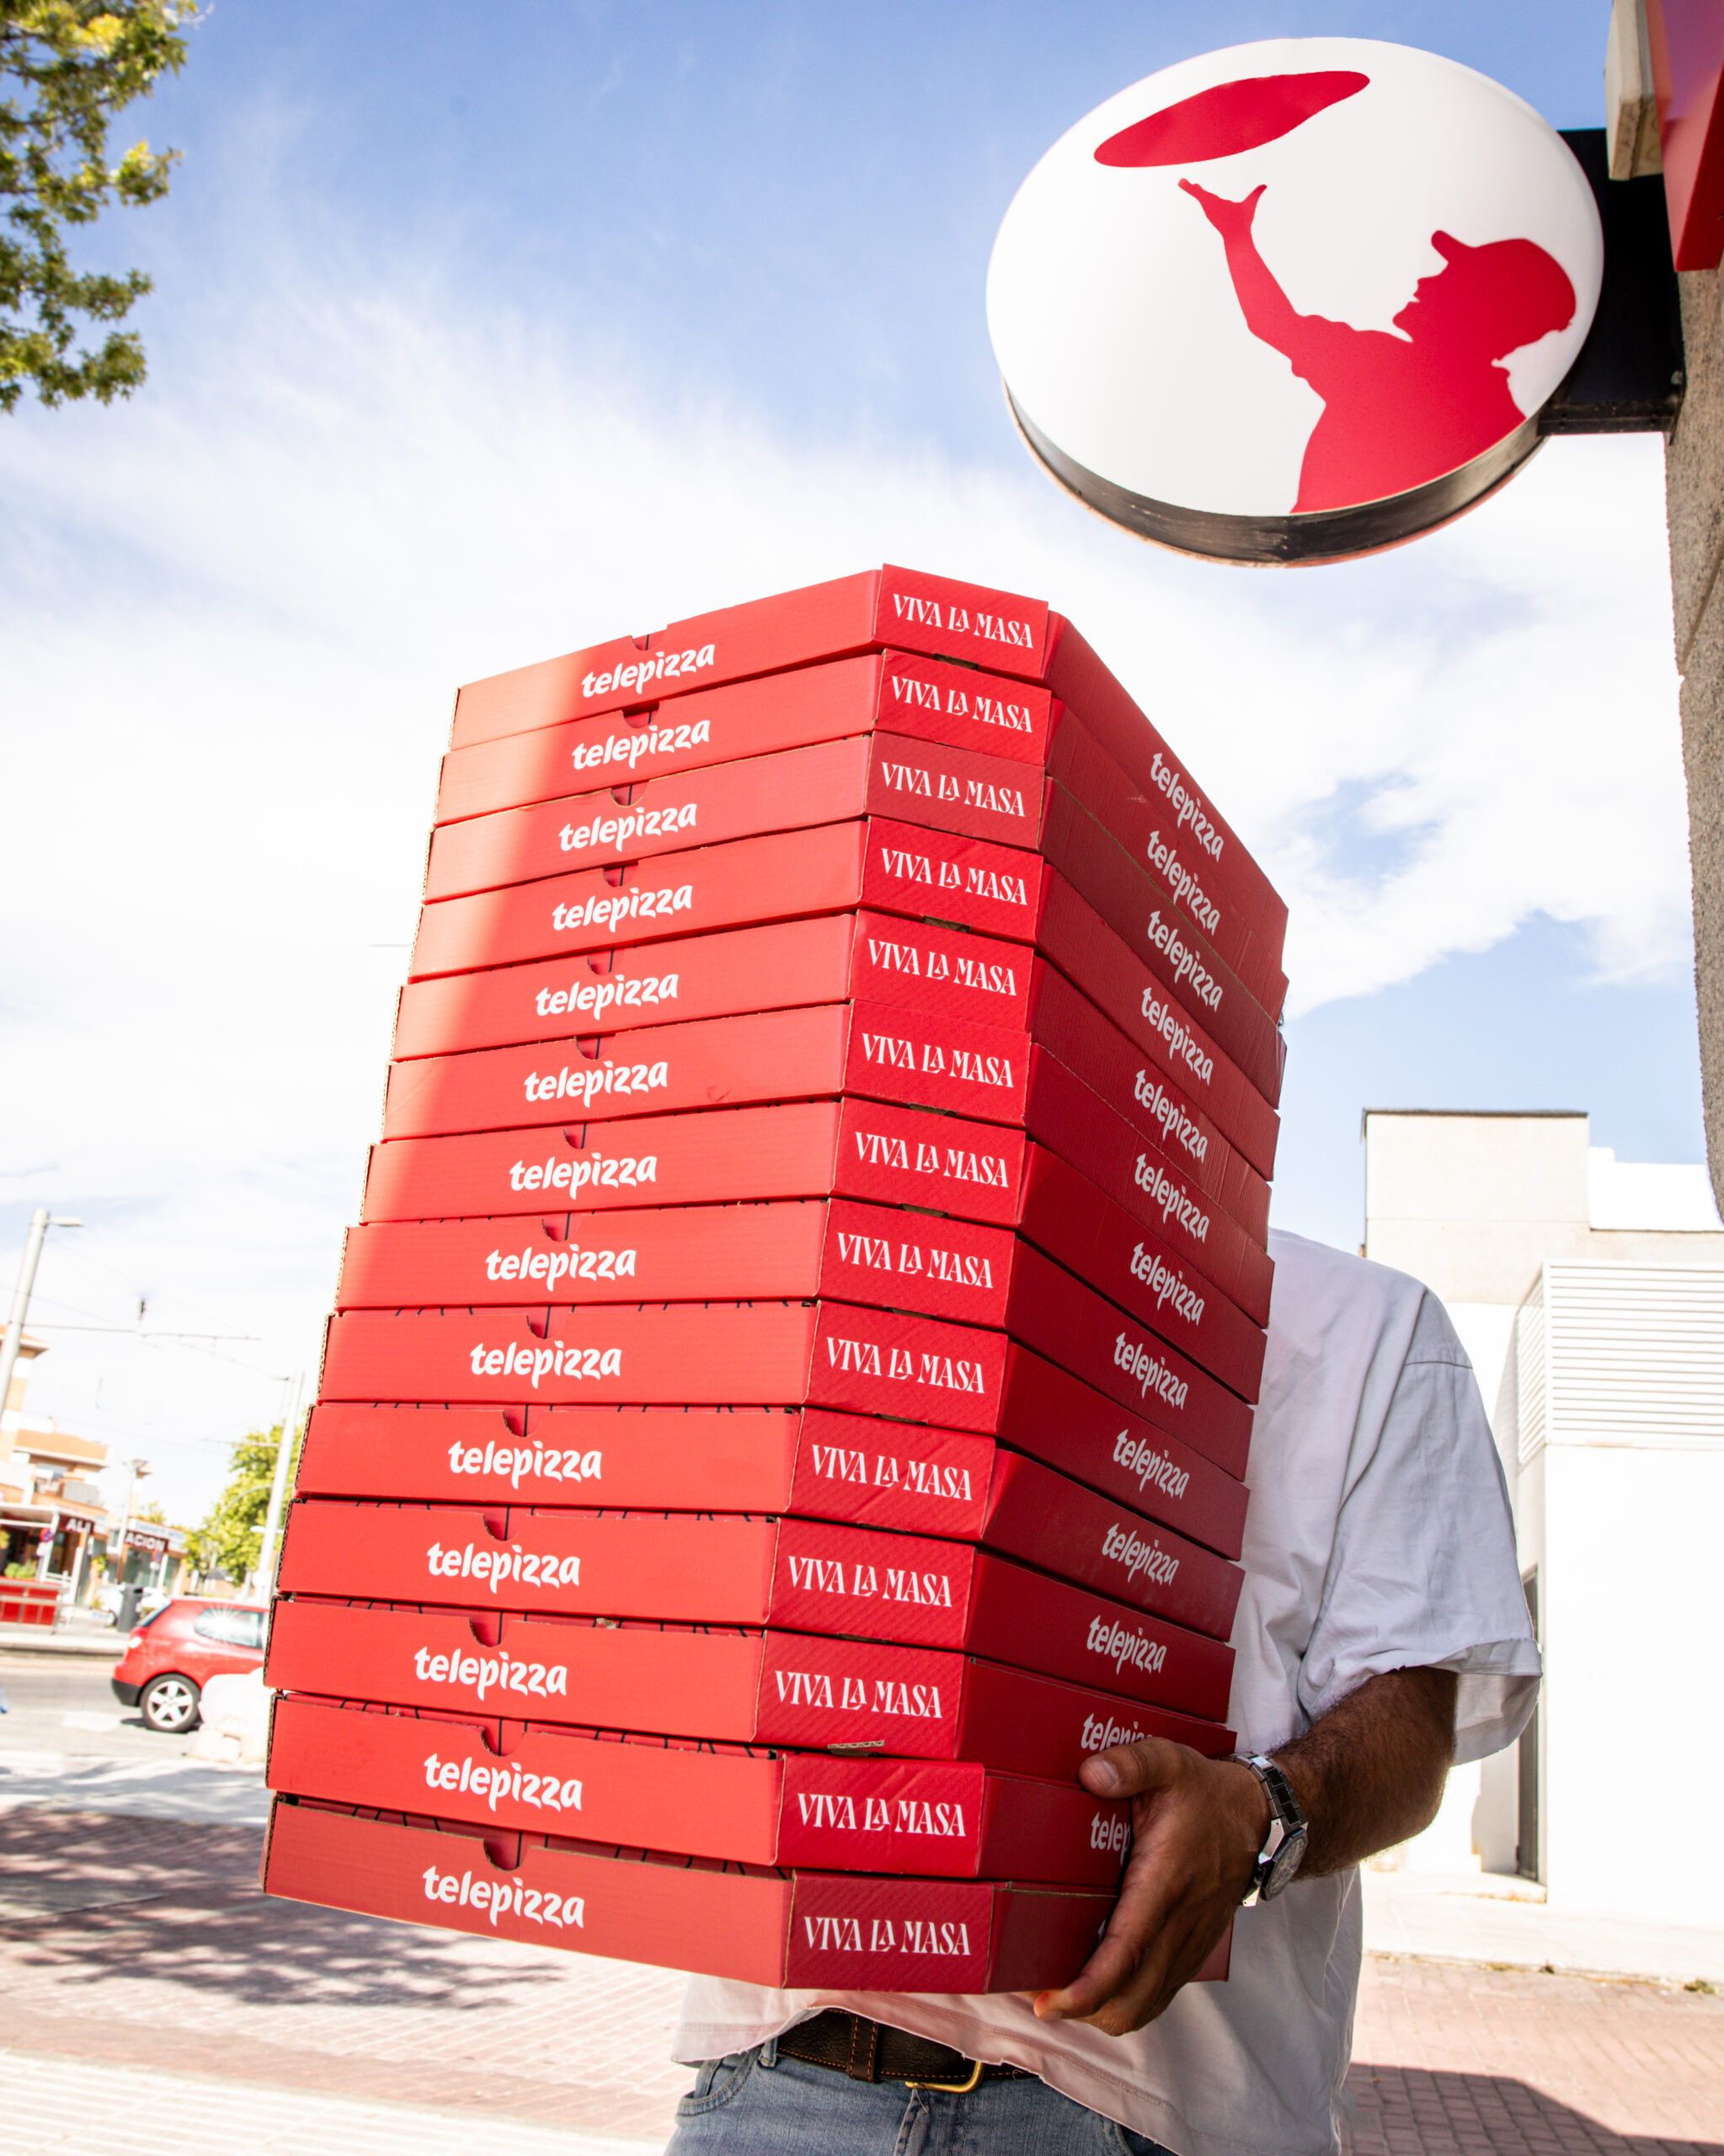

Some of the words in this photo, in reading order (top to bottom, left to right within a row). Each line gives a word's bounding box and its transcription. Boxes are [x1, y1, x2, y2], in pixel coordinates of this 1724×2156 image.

[893, 593, 942, 628] VIVA
[947, 606, 970, 632] LA
[973, 612, 1034, 649] MASA
[580, 643, 716, 699] telepizza
[891, 675, 941, 711] VIVA
[946, 689, 969, 716] LA
[972, 696, 1033, 734] MASA
[570, 718, 712, 771] telepizza
[881, 761, 932, 798] VIVA
[937, 774, 961, 802] LA
[963, 780, 1026, 818] MASA
[1150, 752, 1225, 863] telepizza
[557, 801, 700, 853] telepizza
[881, 847, 933, 884] VIVA
[937, 861, 962, 889] LA
[964, 867, 1027, 906] MASA
[1146, 830, 1221, 937] telepizza
[551, 883, 695, 934] telepizza
[867, 938, 921, 976] VIVA
[926, 951, 950, 980] LA
[953, 958, 1017, 996] MASA
[1146, 910, 1224, 1012] telepizza
[534, 973, 681, 1022] telepizza
[862, 1033, 916, 1070] VIVA
[921, 1044, 946, 1074] LA
[949, 1049, 1014, 1088] MASA
[1140, 986, 1214, 1086] telepizza
[523, 1059, 670, 1109] telepizza
[1134, 1069, 1209, 1164] telepizza
[508, 1151, 659, 1200] telepizza
[855, 1131, 910, 1170] VIVA
[915, 1143, 940, 1174] LA
[942, 1148, 1009, 1188] MASA
[1134, 1153, 1210, 1243] telepizza
[484, 1242, 638, 1293] telepizza
[837, 1232, 893, 1271] VIVA
[897, 1243, 923, 1275] LA
[926, 1249, 994, 1289] MASA
[1129, 1242, 1205, 1326] telepizza
[468, 1339, 623, 1390] telepizza
[826, 1337, 882, 1376] VIVA
[887, 1348, 914, 1380] LA
[916, 1353, 985, 1394] MASA
[1113, 1332, 1189, 1411] telepizza
[447, 1439, 603, 1491] telepizza
[812, 1444, 867, 1484] VIVA
[873, 1454, 899, 1488] LA
[903, 1460, 972, 1501] MASA
[1113, 1428, 1190, 1500] telepizza
[426, 1542, 581, 1595] telepizza
[788, 1556, 846, 1594] VIVA
[851, 1564, 878, 1598] LA
[882, 1568, 953, 1608] MASA
[1101, 1522, 1180, 1586] telepizza
[1086, 1615, 1167, 1674] telepizza
[413, 1646, 568, 1702] telepizza
[775, 1670, 834, 1708] VIVA
[841, 1677, 867, 1710] LA
[871, 1680, 942, 1719] MASA
[423, 1753, 584, 1812] telepizza
[798, 1793, 857, 1830] VIVA
[863, 1797, 890, 1832] LA
[894, 1800, 966, 1837] MASA
[1090, 1812, 1131, 1867] telep
[421, 1865, 585, 1929] telepizza
[803, 1916, 863, 1951] VIVA
[870, 1919, 896, 1952] LA
[900, 1920, 970, 1956] MASA
